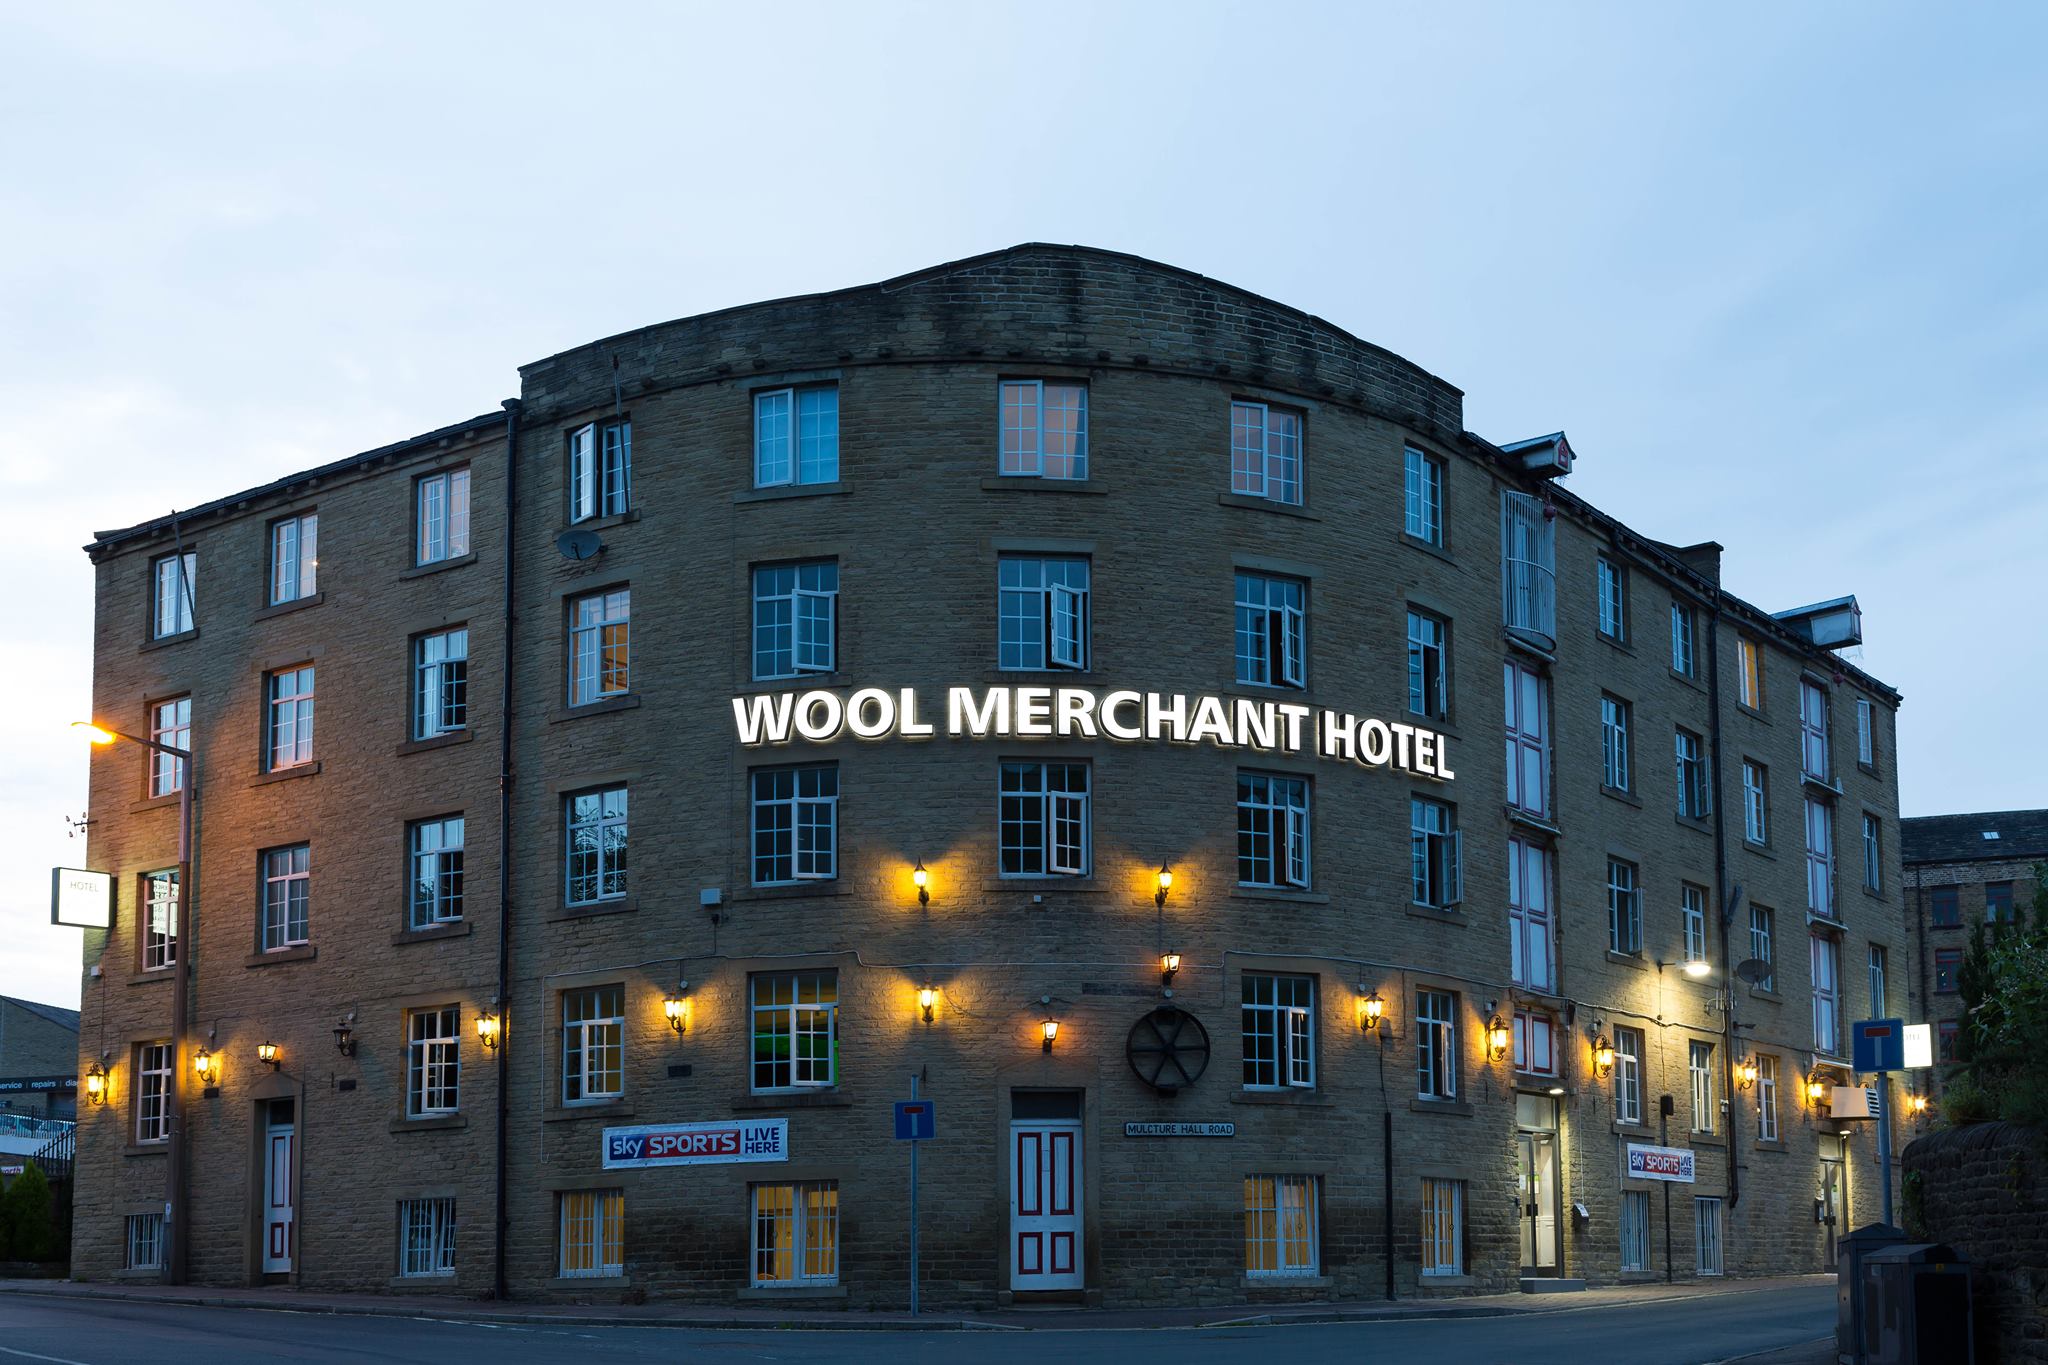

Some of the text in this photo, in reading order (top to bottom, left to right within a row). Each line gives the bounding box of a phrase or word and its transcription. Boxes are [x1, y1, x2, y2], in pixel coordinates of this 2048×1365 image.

[732, 687, 1455, 781] WOOL MERCHANT HOTEL
[70, 881, 99, 893] HOTEL
[31, 1080, 57, 1089] repairs
[65, 1079, 78, 1087] dia
[745, 1127, 780, 1141] LIVE
[1127, 1124, 1233, 1134] MULCTURE HALL ROAD
[612, 1133, 737, 1158] sky SPORTS
[745, 1141, 780, 1154] HERE
[1632, 1152, 1679, 1172] sky SPORTS
[1681, 1167, 1692, 1176] HERE
